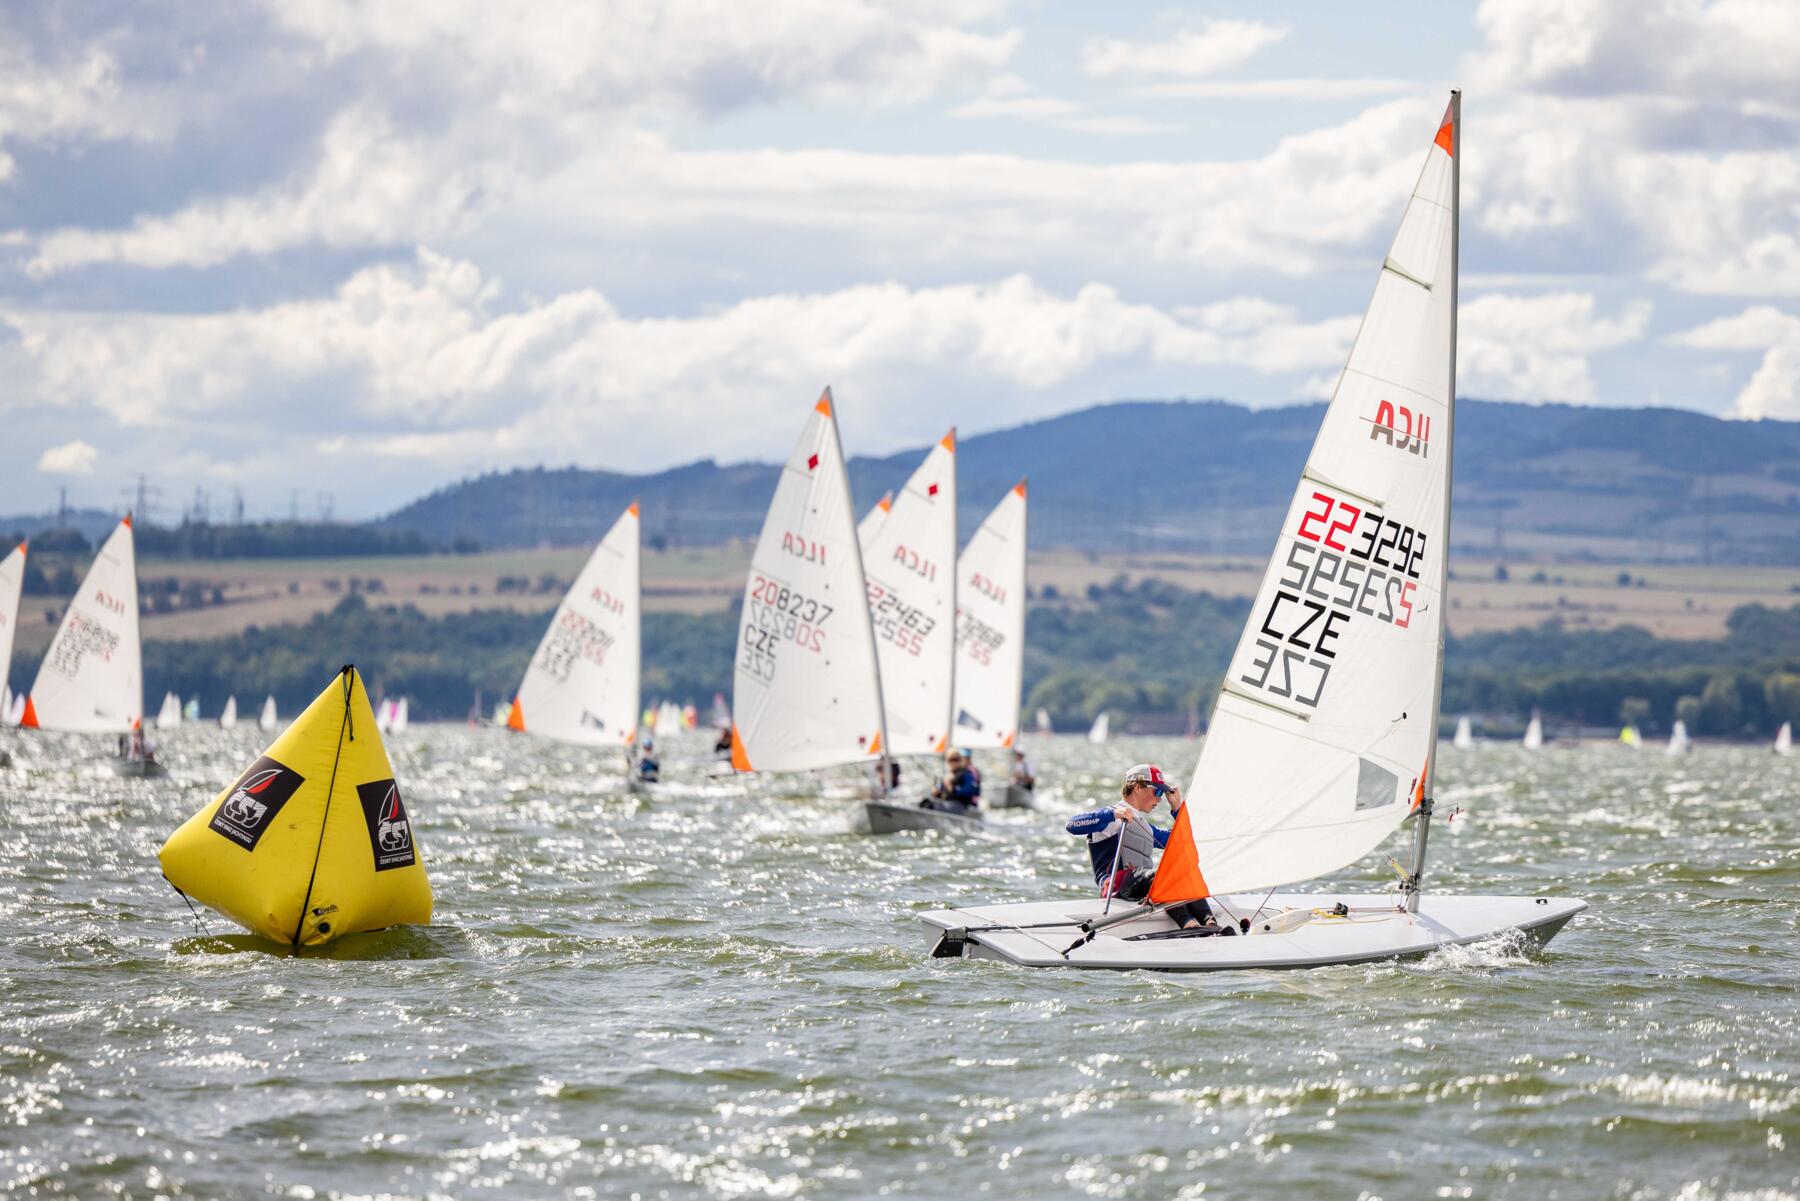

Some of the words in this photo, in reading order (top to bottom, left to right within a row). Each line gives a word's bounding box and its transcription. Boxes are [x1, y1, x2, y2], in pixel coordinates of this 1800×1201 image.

[1297, 492, 1427, 579] 223292
[752, 576, 833, 626] 208237
[865, 581, 936, 637] 22463
[1260, 590, 1351, 659] CZE
[744, 623, 781, 660] CZE
